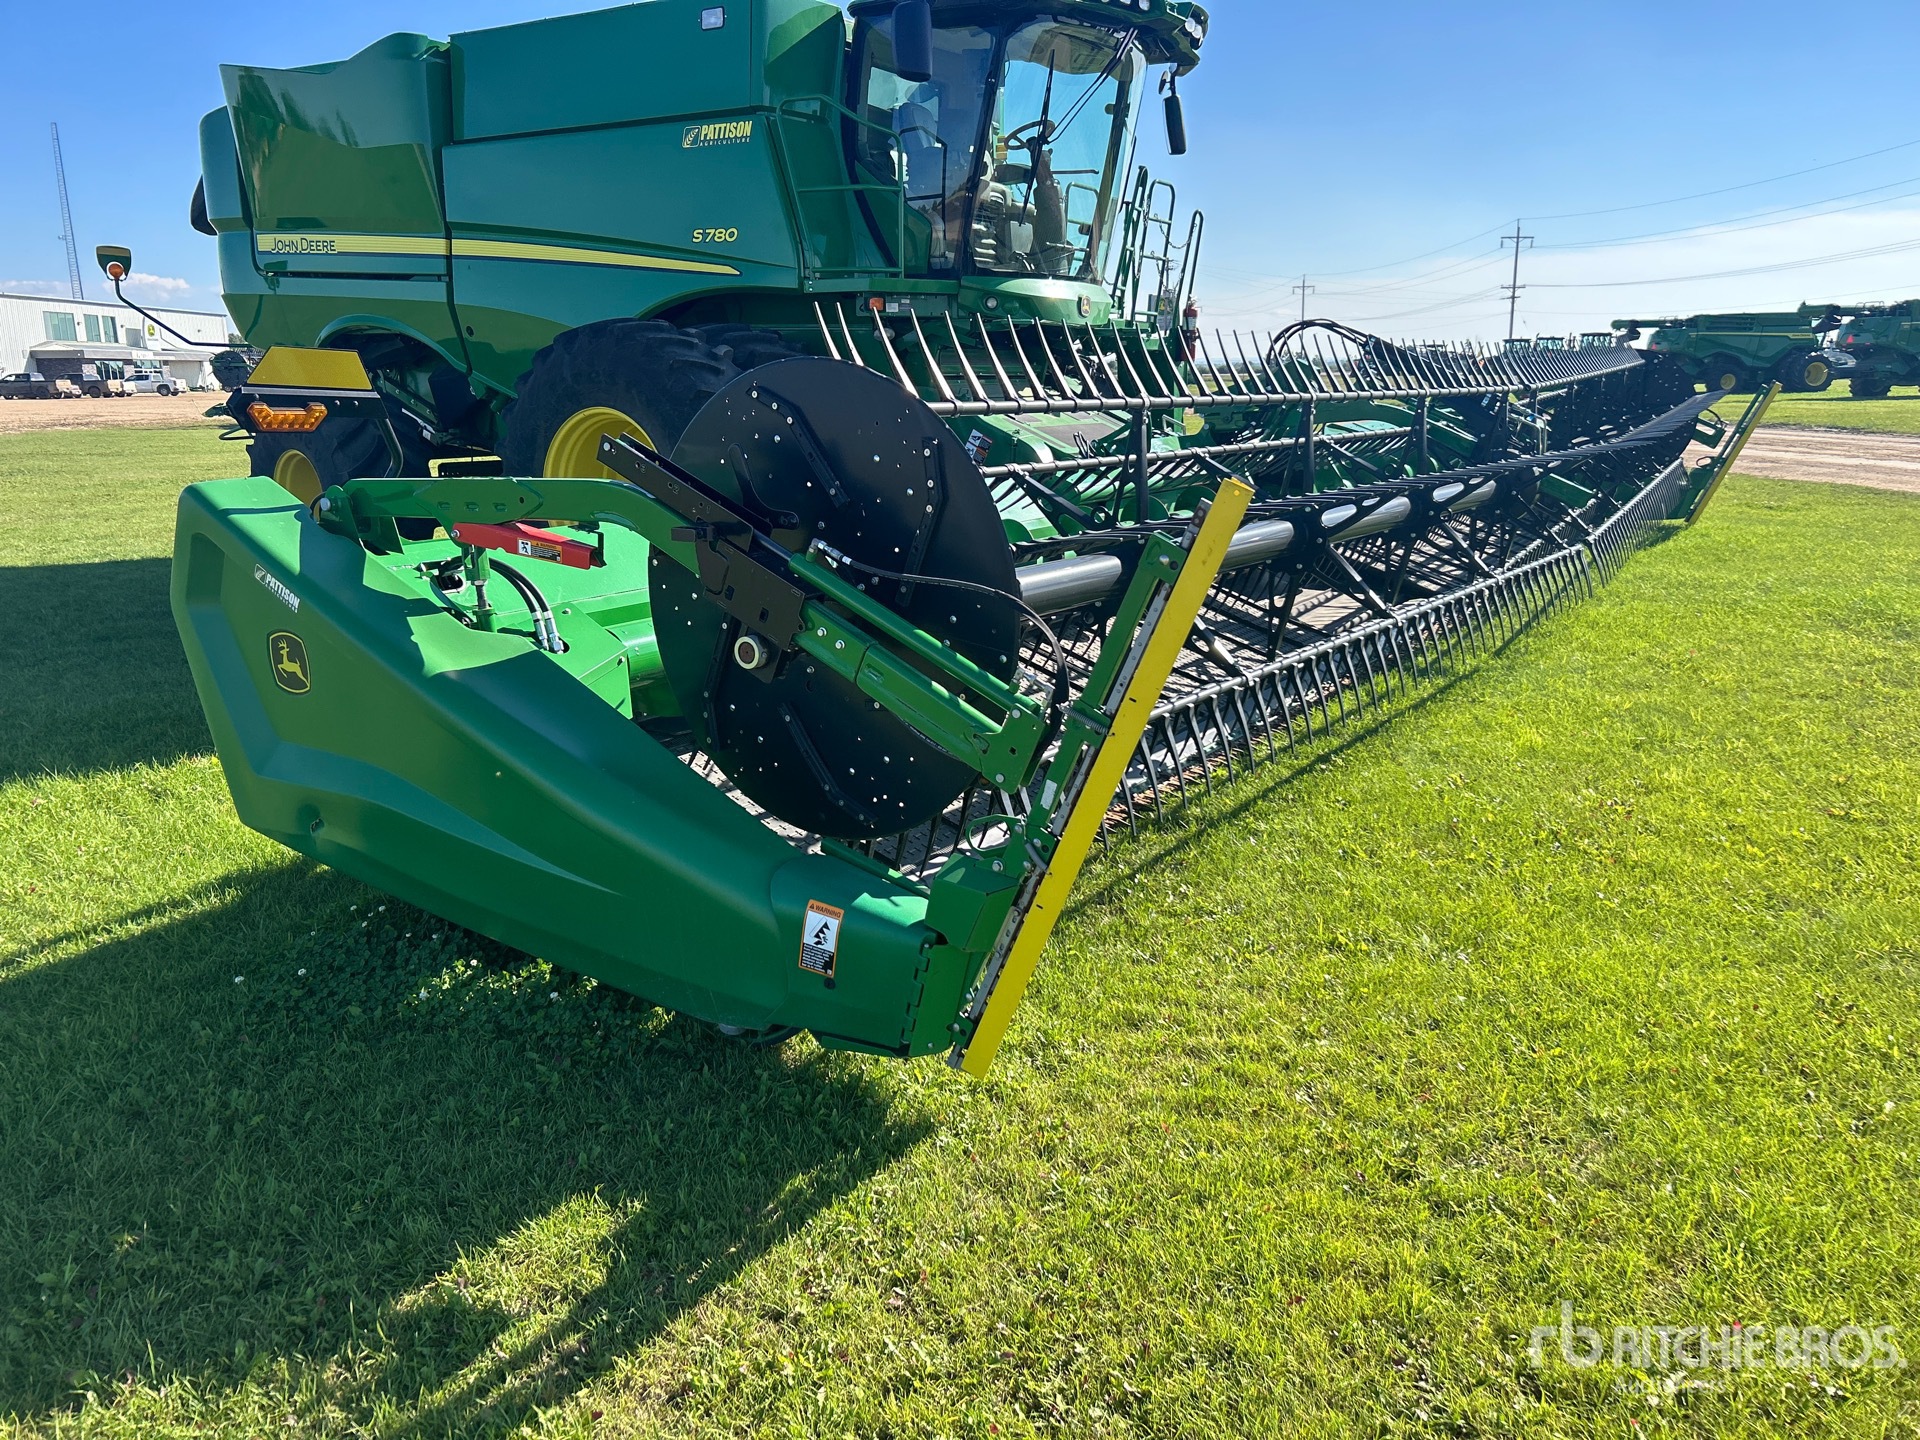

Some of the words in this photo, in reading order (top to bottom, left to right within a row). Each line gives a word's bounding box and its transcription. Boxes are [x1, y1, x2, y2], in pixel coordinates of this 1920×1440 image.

[701, 121, 753, 140] PATTISON
[700, 137, 750, 147] AGRICULTURE
[271, 237, 299, 252] JOHN
[300, 238, 337, 253] DEERE
[266, 573, 300, 609] PATTISON
[815, 905, 841, 918] WARNING
